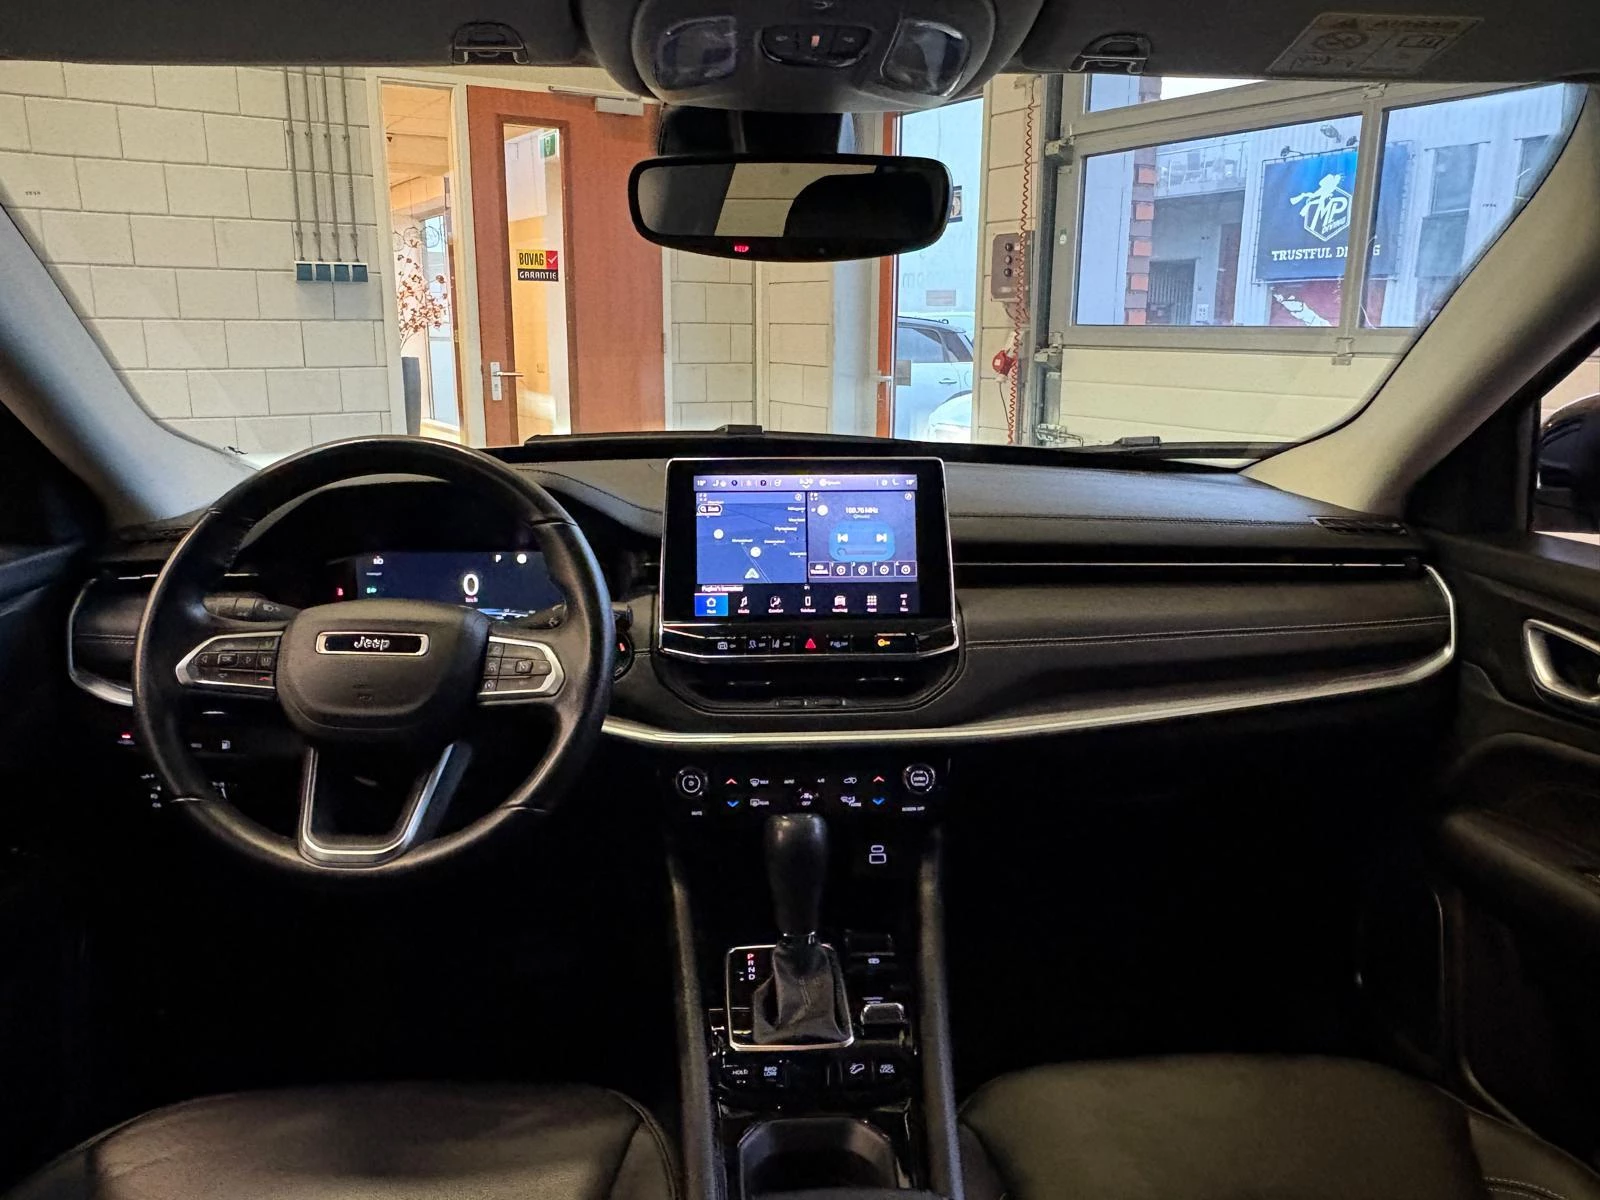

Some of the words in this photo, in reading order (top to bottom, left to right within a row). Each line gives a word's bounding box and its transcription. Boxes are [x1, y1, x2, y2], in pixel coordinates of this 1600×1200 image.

[519, 253, 545, 266] BOVAG
[1271, 248, 1333, 261] TRUSTFUL
[519, 270, 557, 280] GARANTIE
[495, 554, 502, 563] P
[463, 573, 480, 597] 0
[353, 635, 391, 651] Jeep
